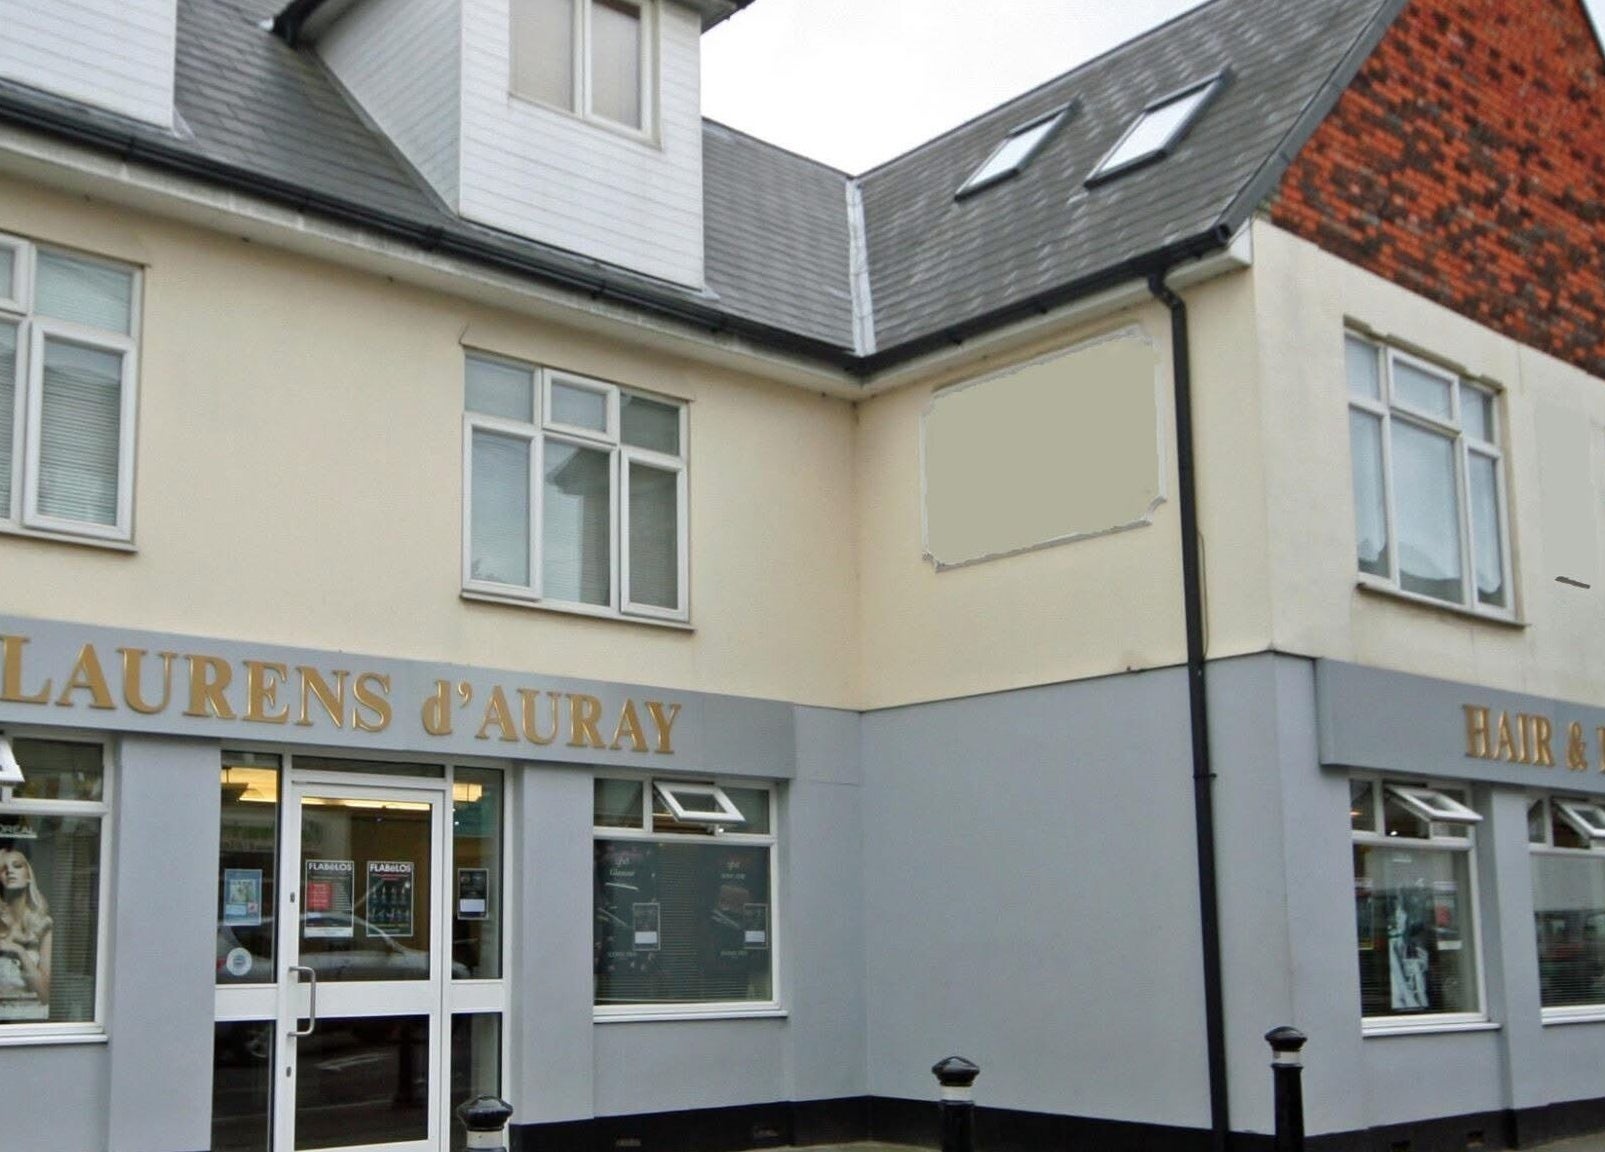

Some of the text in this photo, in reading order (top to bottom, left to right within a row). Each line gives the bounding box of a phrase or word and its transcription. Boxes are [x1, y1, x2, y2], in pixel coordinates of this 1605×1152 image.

[0, 635, 392, 732] LAURENS
[1463, 705, 1554, 766] HAIR
[1566, 721, 1588, 771] &
